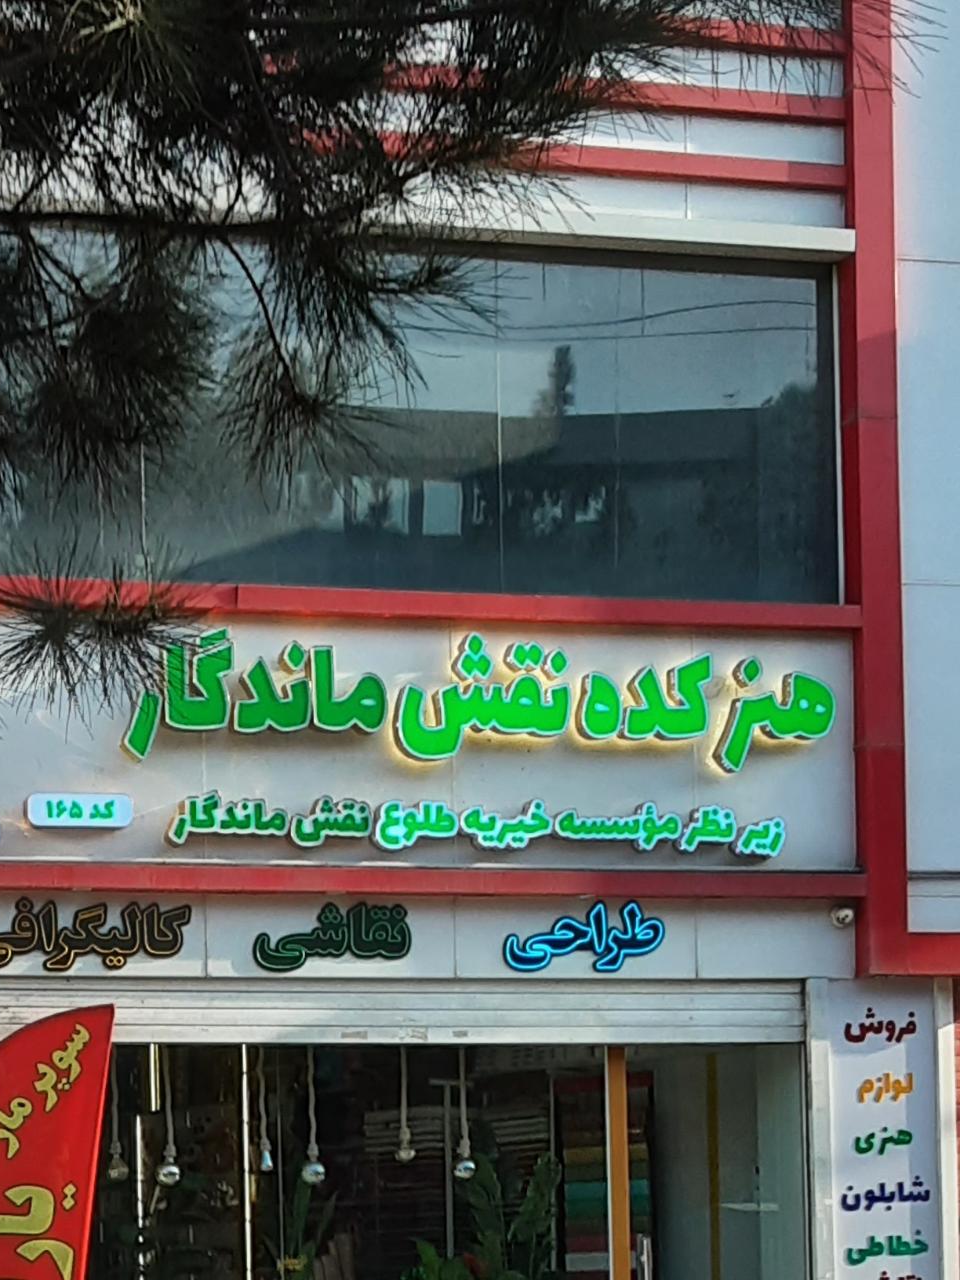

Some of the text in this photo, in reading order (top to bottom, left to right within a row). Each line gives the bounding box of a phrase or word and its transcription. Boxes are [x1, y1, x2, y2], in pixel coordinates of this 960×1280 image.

[121, 627, 388, 761] ماندگار
[396, 632, 571, 760] نقش
[45, 799, 115, 820] کد ۱۶۵
[168, 790, 289, 845] ماندگار
[290, 795, 372, 847] نقش
[375, 800, 459, 849] طلوع
[460, 800, 552, 848] خیریه
[680, 804, 736, 852] نظر
[737, 817, 786, 857] زیر
[252, 901, 412, 972] نقاشی
[502, 900, 665, 972] طراحی
[844, 1007, 917, 1043] فروش
[857, 1072, 914, 1104] لوازم
[854, 1127, 913, 1155] هنری
[841, 1175, 931, 1212] شابلون
[846, 1229, 929, 1266] خطاطی
